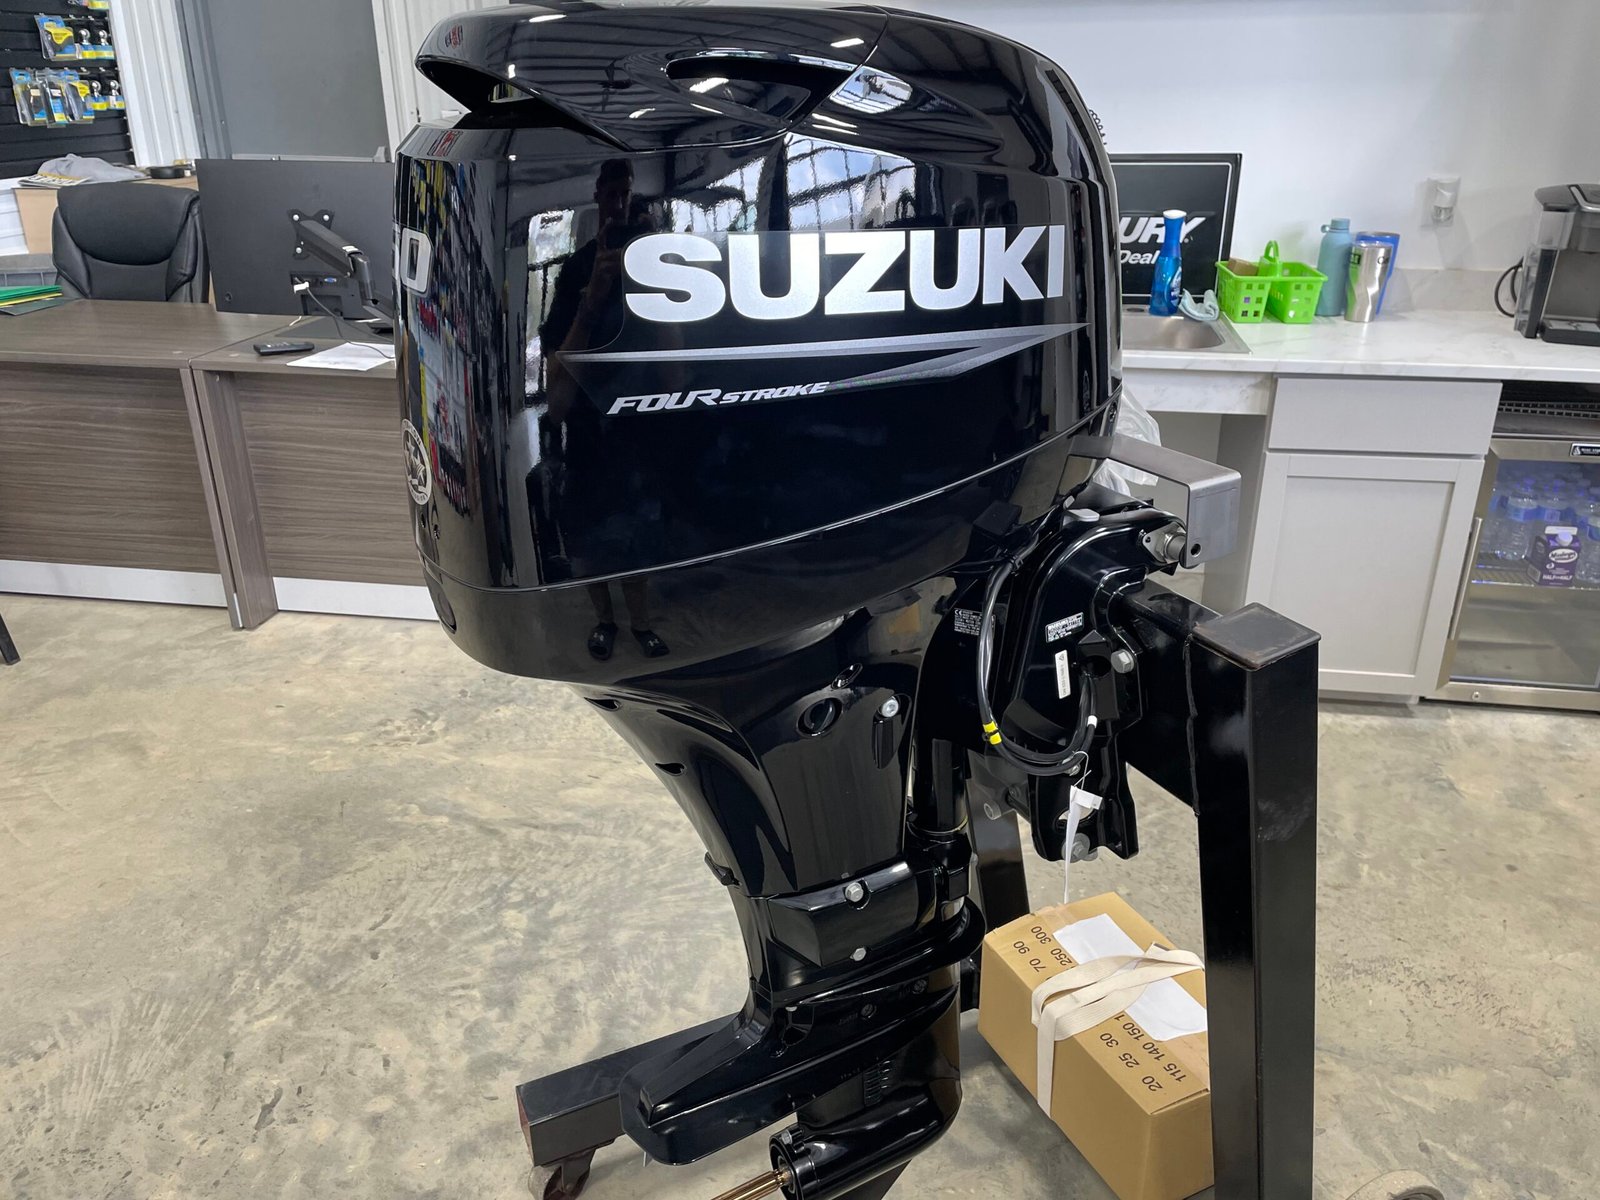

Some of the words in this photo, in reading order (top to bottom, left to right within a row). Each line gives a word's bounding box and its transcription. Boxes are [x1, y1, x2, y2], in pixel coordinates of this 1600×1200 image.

[623, 224, 1065, 322] SUZUKI
[606, 388, 722, 415] FOUR
[720, 381, 830, 405] STROKE
[1030, 925, 1052, 945] 300
[1013, 940, 1030, 955] 90
[1050, 947, 1073, 966] 250
[1029, 958, 1047, 973] 70
[1099, 1032, 1119, 1048] 30
[1122, 1022, 1145, 1041] 150
[1118, 1052, 1140, 1068] 25
[1142, 1041, 1166, 1061] 140
[1163, 1062, 1187, 1082] 115
[1141, 1075, 1163, 1092] 20
